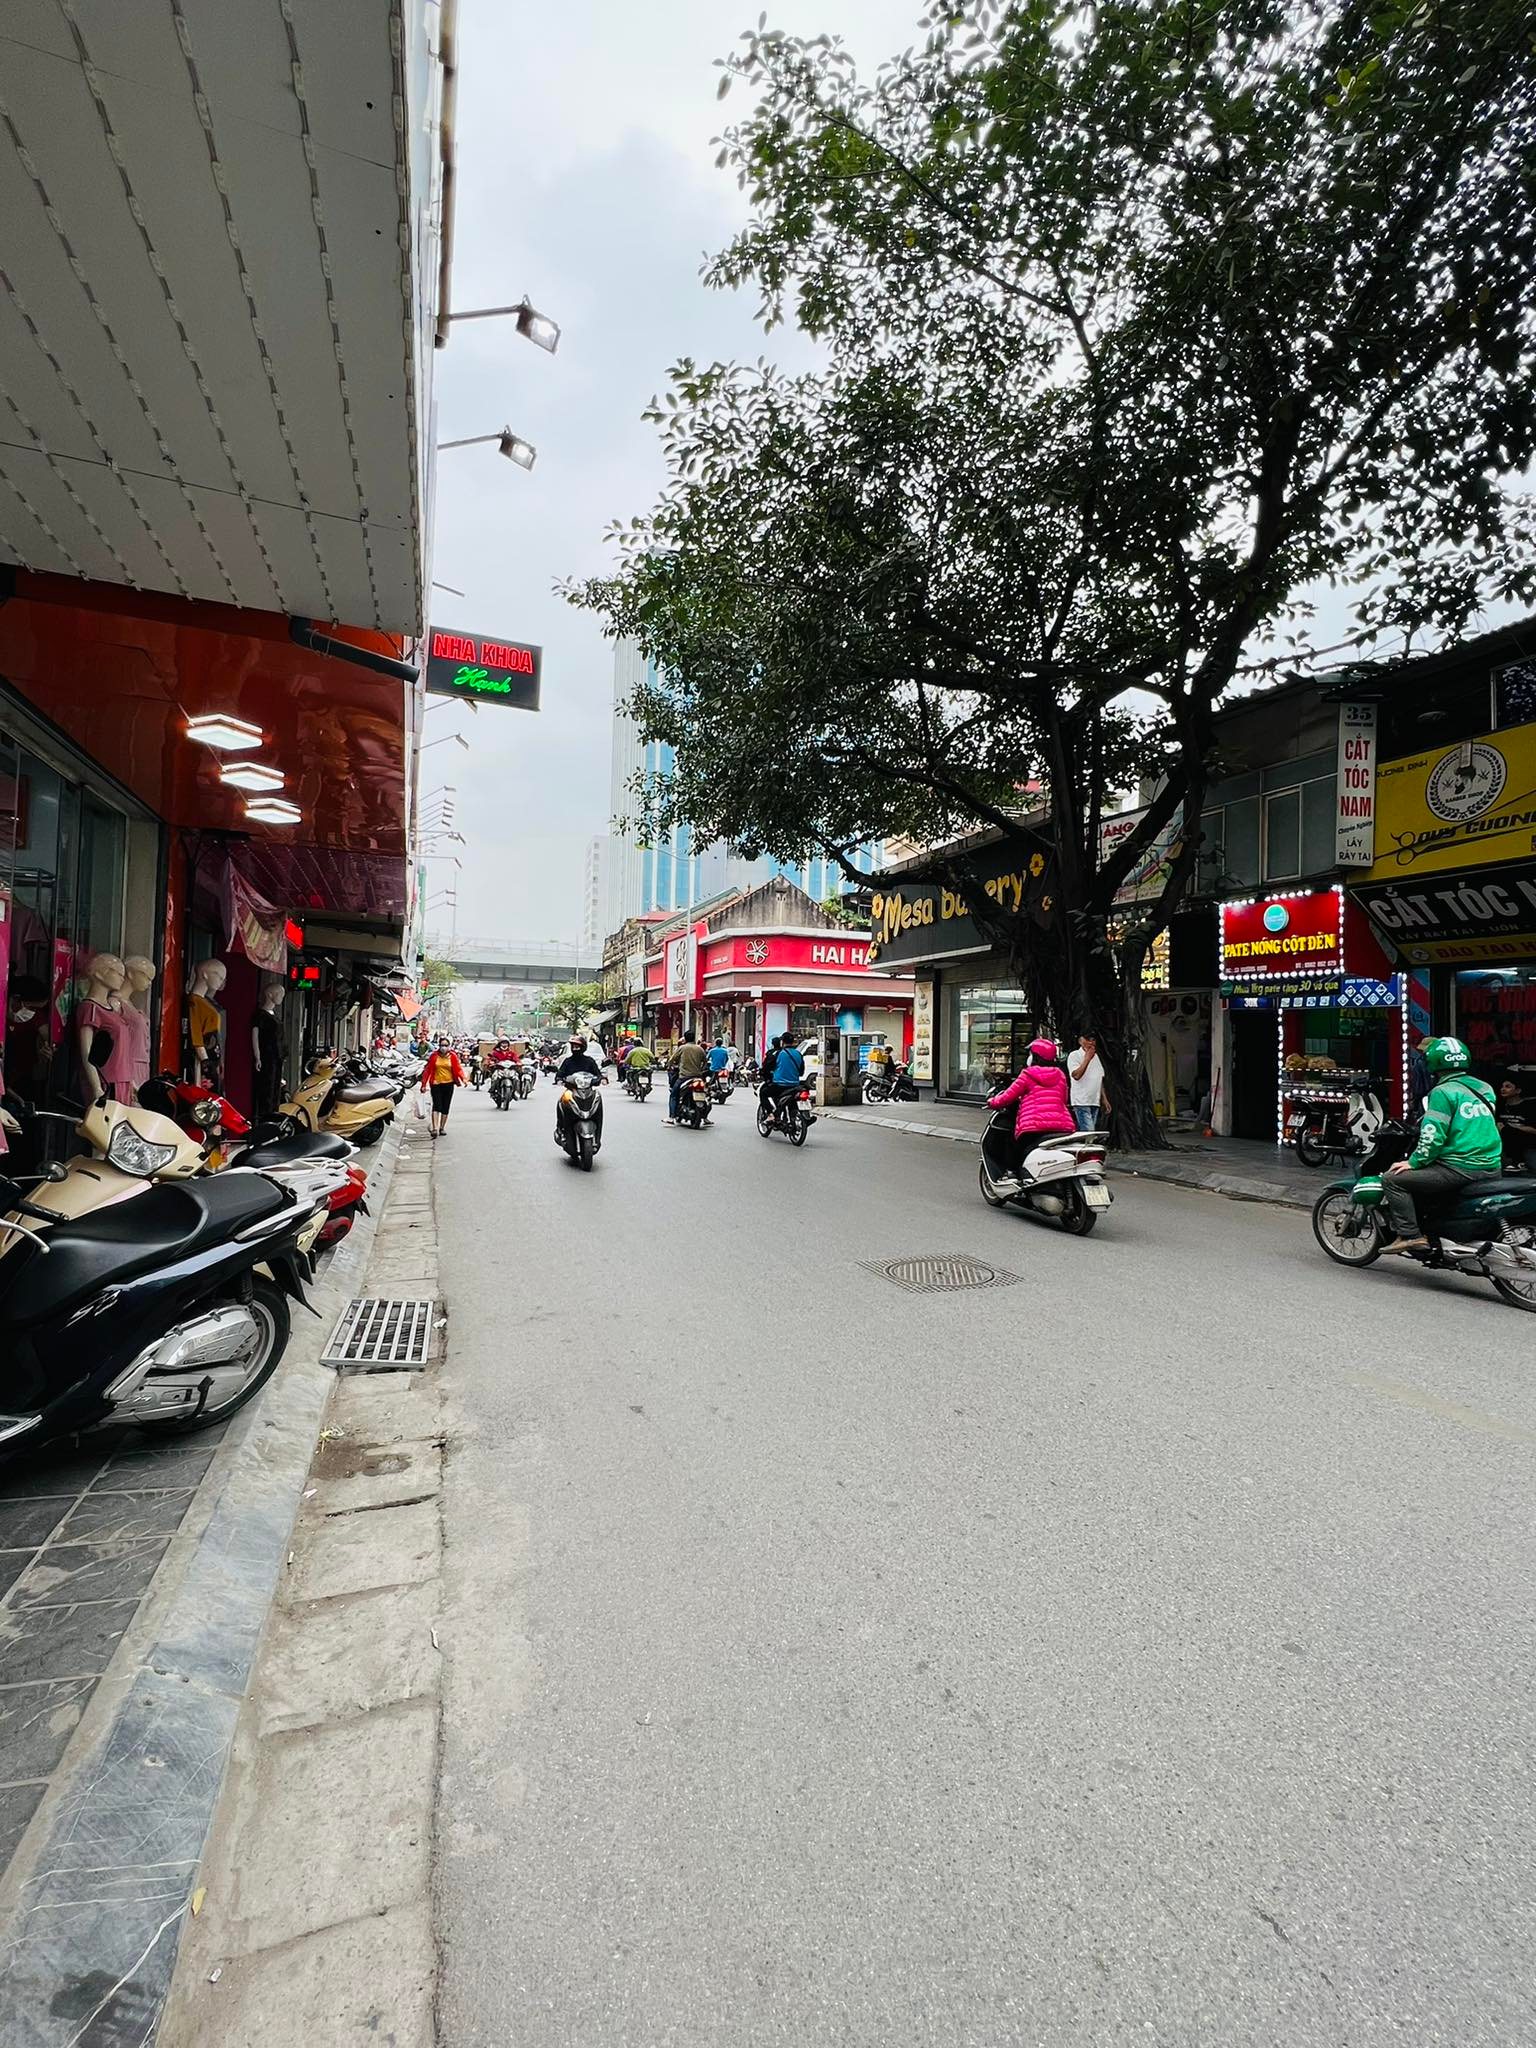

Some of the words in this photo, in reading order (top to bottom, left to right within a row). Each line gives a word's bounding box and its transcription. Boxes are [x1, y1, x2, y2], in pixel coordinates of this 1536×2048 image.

[433, 633, 476, 663] NHA
[480, 642, 534, 674] KHOA
[1346, 706, 1372, 721] 35
[1344, 733, 1371, 761] CẮT
[1344, 763, 1369, 789] TÓC
[1340, 796, 1372, 817] NAM
[1358, 852, 1371, 861] TAI
[883, 892, 934, 944] Mesa
[812, 944, 845, 964] HAI
[1224, 941, 1251, 958] PATE
[1251, 937, 1282, 956] NÓNG
[1282, 934, 1308, 956] CỘT
[1308, 931, 1337, 951] ĐÈN
[1299, 980, 1312, 991] 30
[1444, 1052, 1468, 1062] Grab
